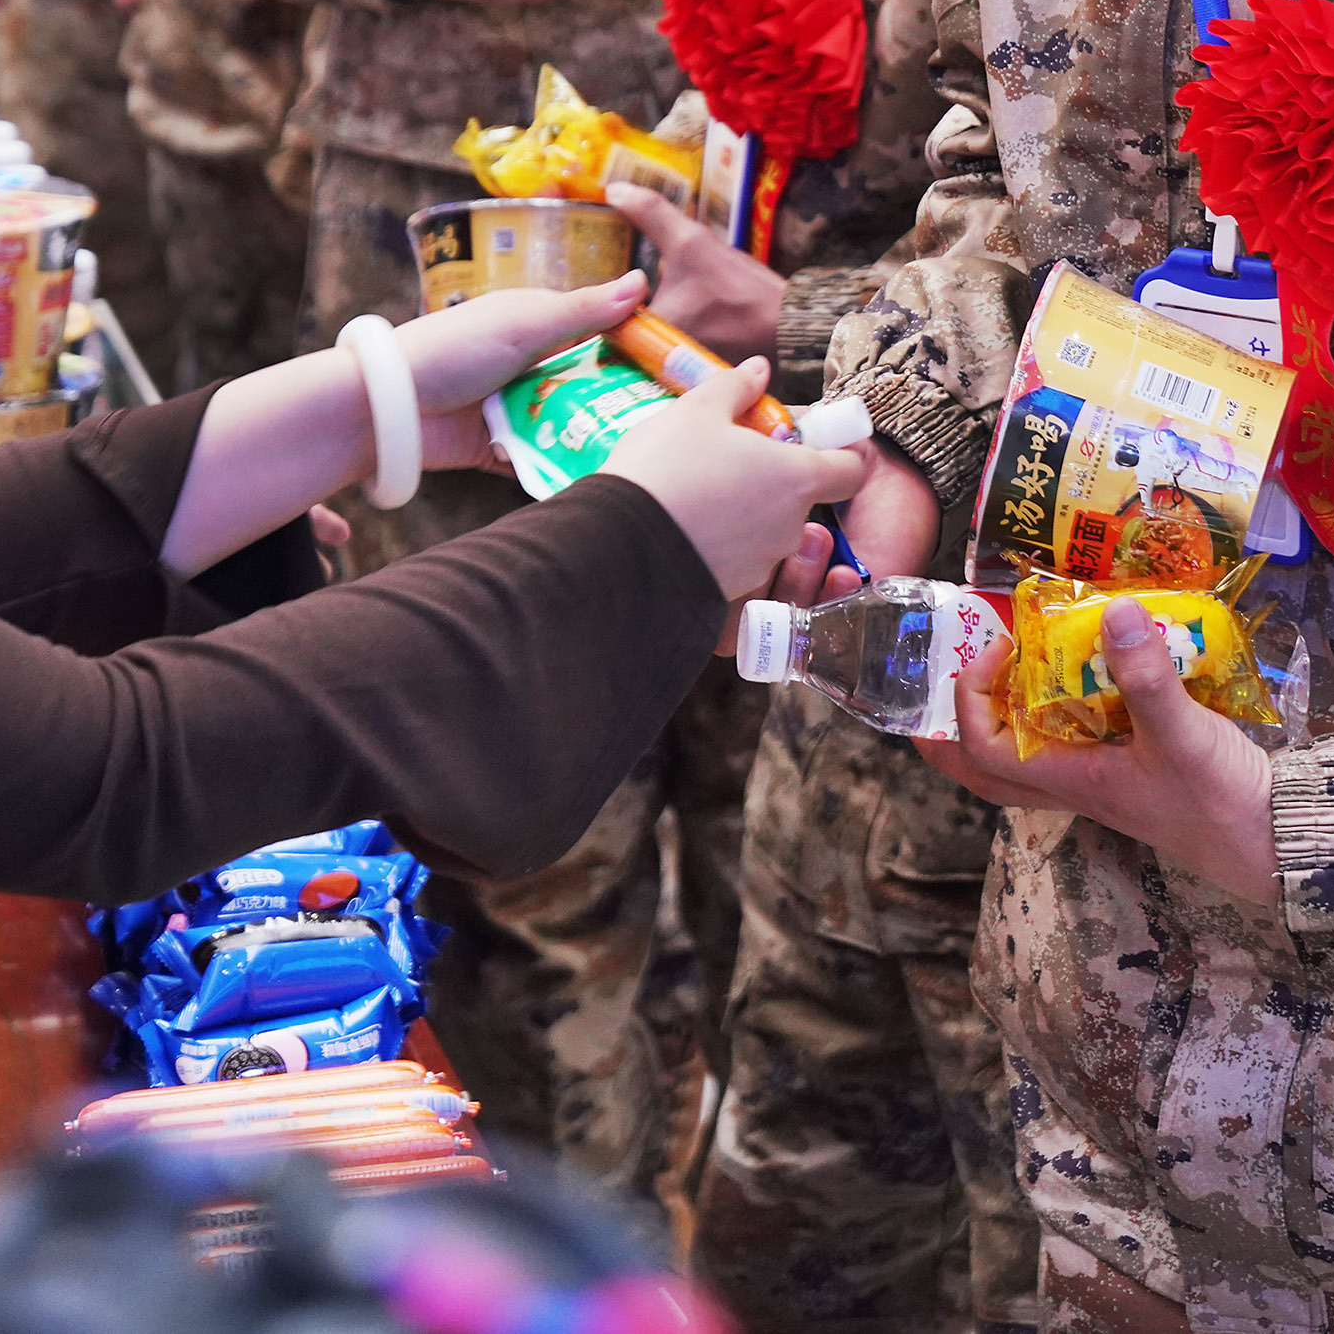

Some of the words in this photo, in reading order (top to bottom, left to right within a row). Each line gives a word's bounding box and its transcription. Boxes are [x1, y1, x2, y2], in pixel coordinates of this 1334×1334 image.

[999, 412, 1069, 535] 汤好喝
[217, 868, 283, 891] OREO
